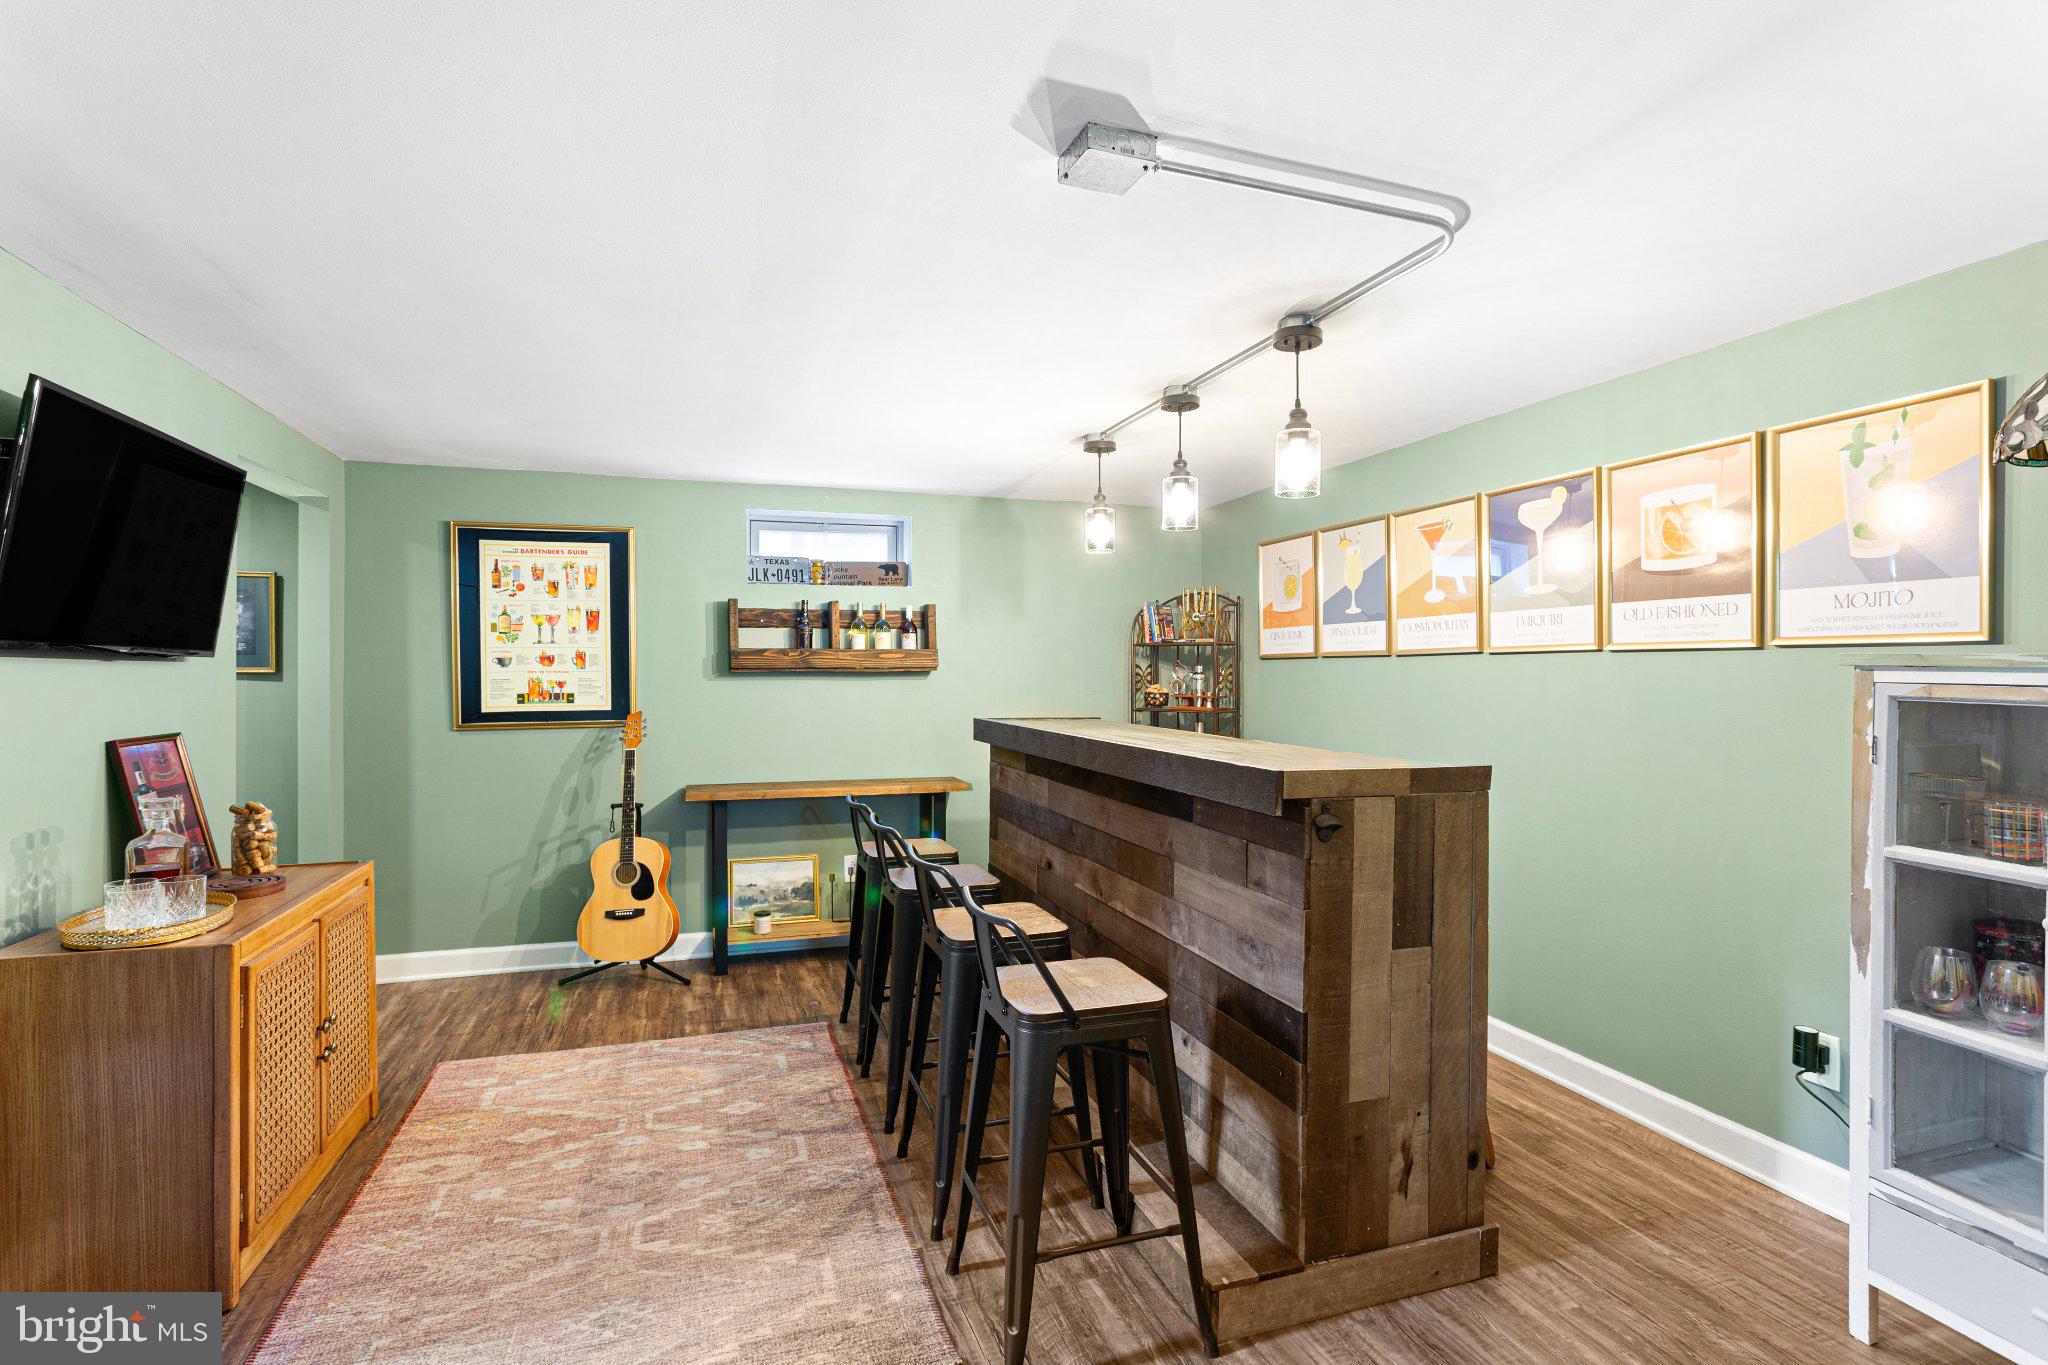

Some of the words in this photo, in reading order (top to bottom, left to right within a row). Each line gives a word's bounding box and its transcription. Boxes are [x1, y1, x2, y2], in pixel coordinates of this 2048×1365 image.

[748, 567, 769, 582] JLK
[776, 568, 805, 583] 0491
[1833, 589, 1914, 609] MOJITO
[1623, 606, 1653, 621] OLD
[1656, 602, 1739, 619] FASHIONED
[1402, 618, 1471, 634] COSMOPOLITAN
[1515, 612, 1564, 628] DAIQUIRI
